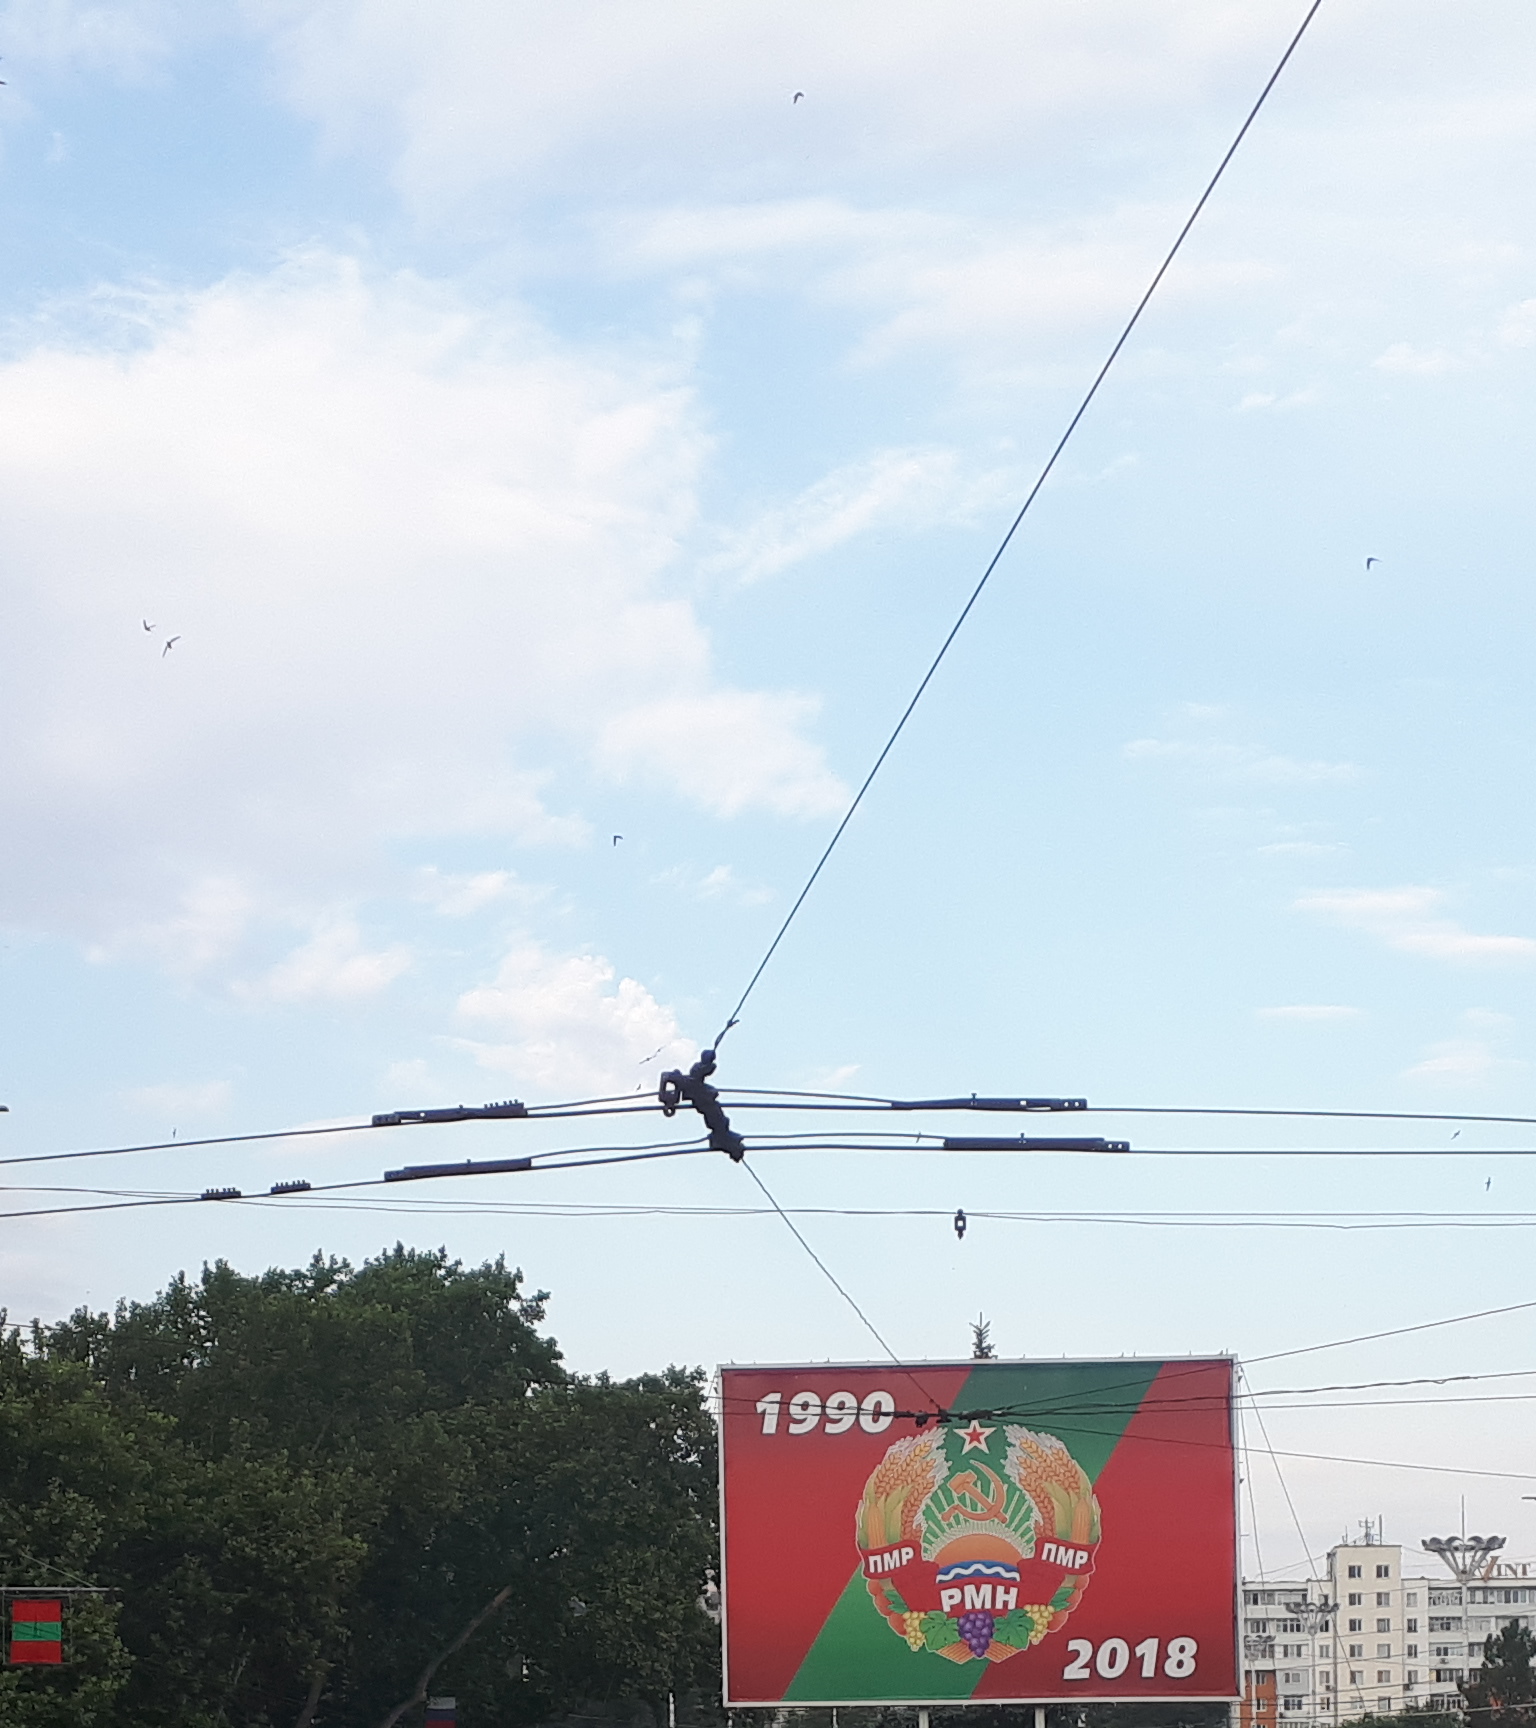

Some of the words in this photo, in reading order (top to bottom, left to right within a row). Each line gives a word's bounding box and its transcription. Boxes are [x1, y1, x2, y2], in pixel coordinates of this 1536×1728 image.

[755, 1390, 895, 1434] 1990
[868, 1547, 914, 1573] ПМР
[1041, 1543, 1089, 1569] ПМР
[1468, 1556, 1531, 1582] VINT
[940, 1584, 1018, 1612] РМН
[1063, 1637, 1198, 1679] 2018
